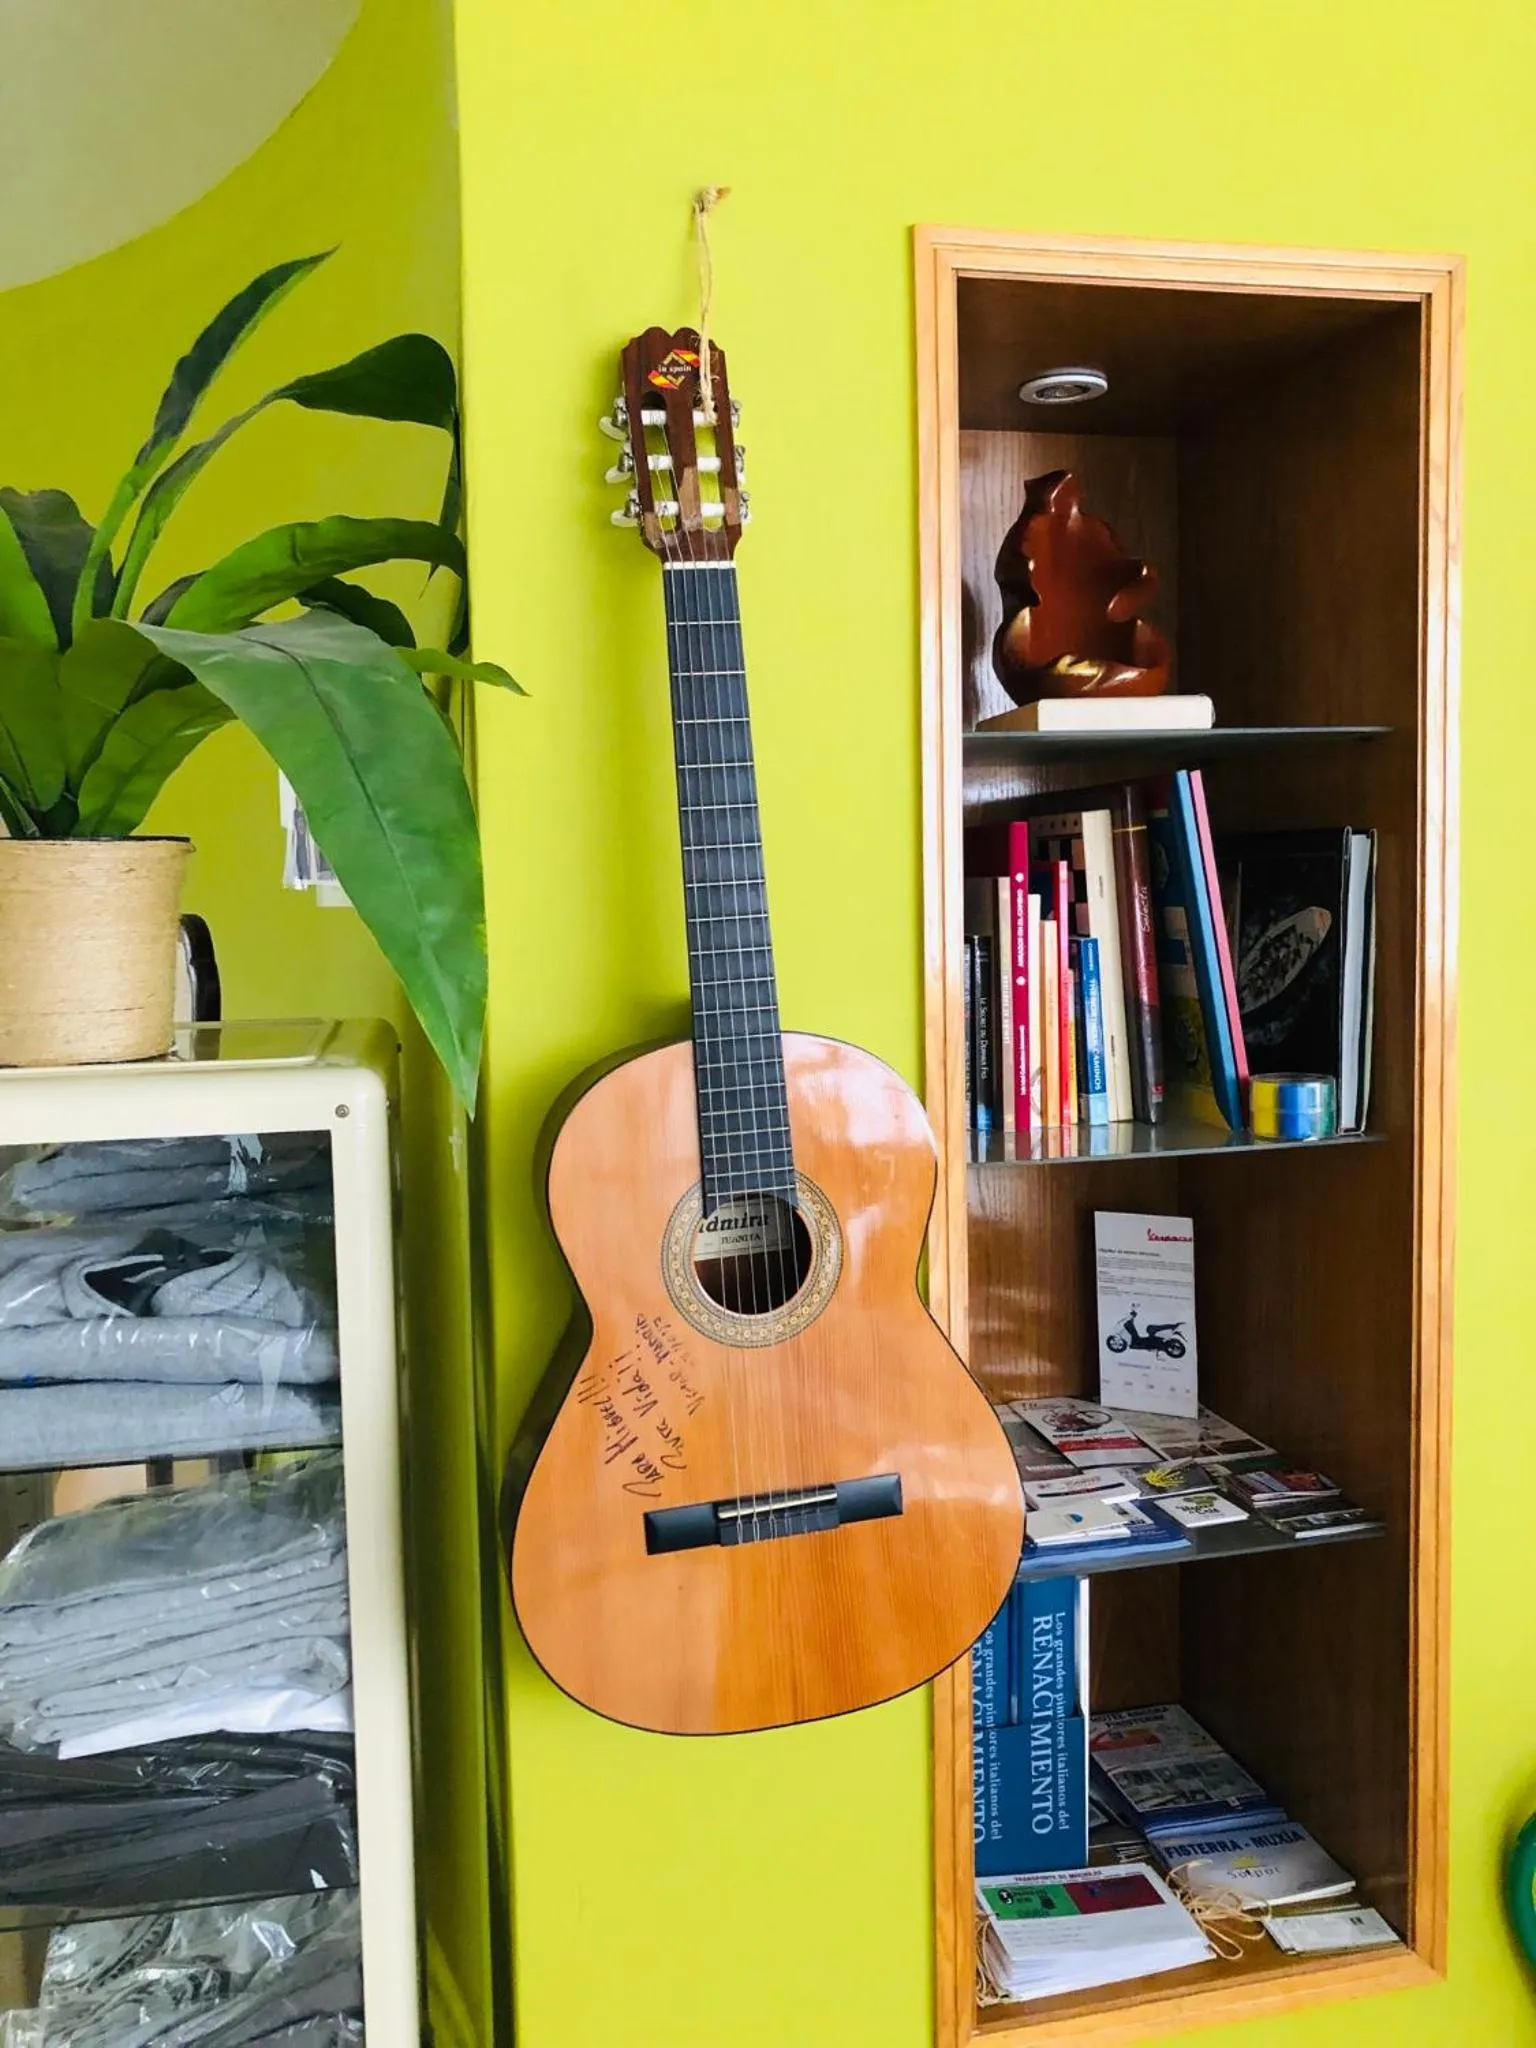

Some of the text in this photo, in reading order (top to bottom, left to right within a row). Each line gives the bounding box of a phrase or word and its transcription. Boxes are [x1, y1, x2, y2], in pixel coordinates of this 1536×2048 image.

[982, 1649, 996, 1698] grandes
[1030, 1614, 1054, 1834] RENACIMIENTO
[1053, 1612, 1070, 1830] Los grandes pintores italianos del
[989, 1762, 1002, 1817] italianos
[990, 1819, 1003, 1840] del
[1164, 1839, 1242, 1859] FISTERRA
